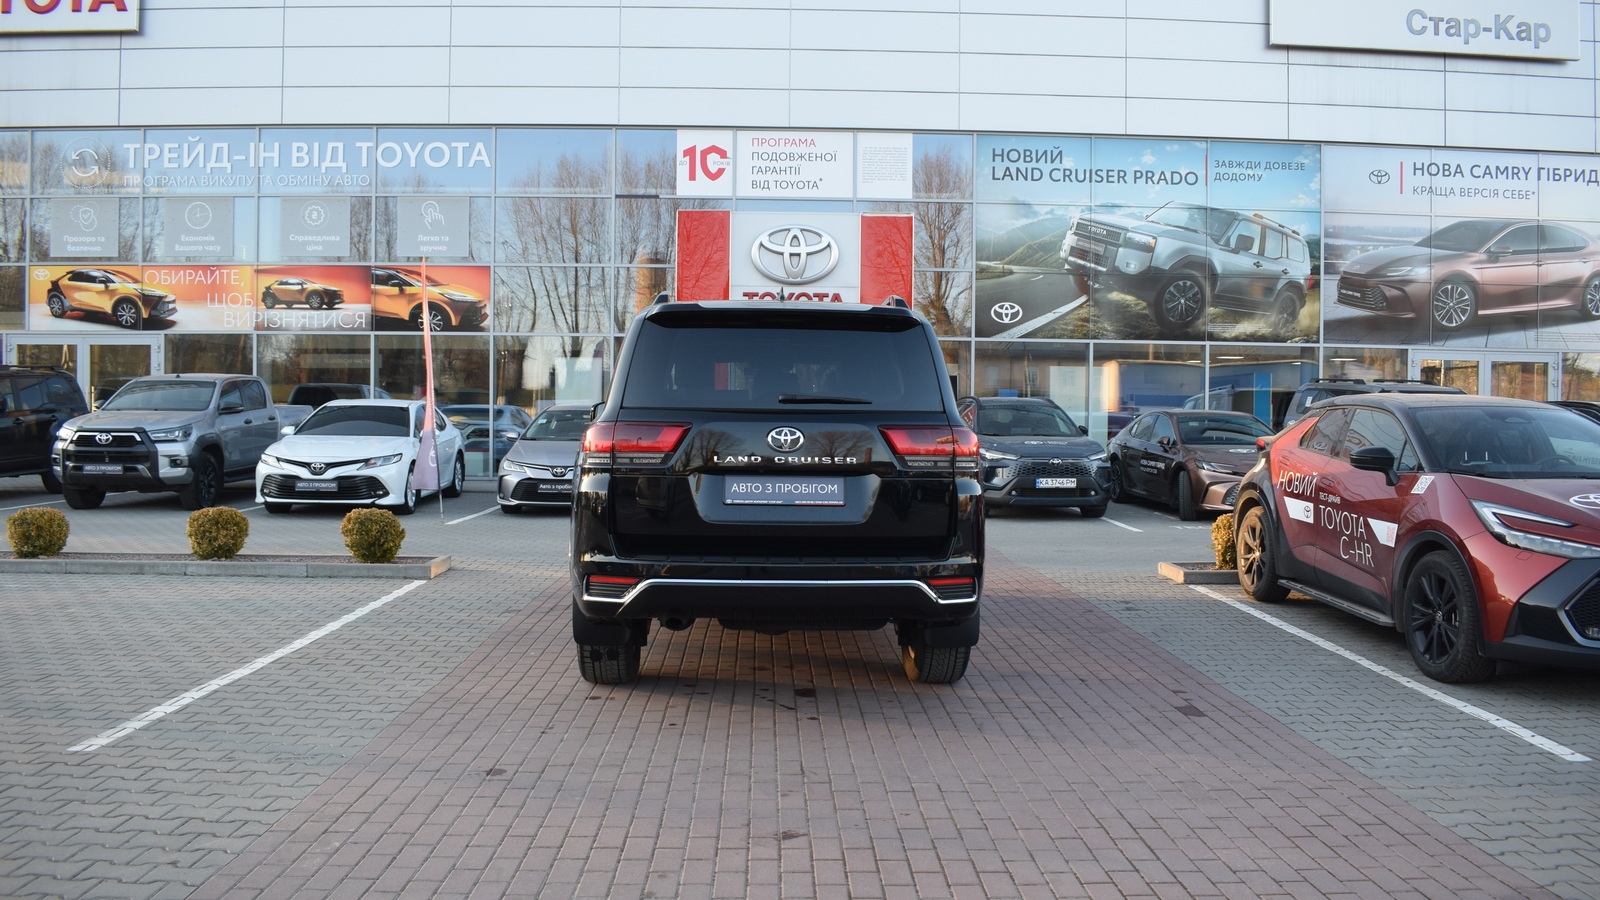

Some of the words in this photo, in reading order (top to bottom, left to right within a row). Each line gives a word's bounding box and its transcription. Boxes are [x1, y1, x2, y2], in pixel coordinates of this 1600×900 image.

[1406, 8, 1551, 49] Стар-Кар
[752, 138, 816, 148] ПРОГРАМА
[123, 136, 281, 174] ТРЕЙД-ІН
[291, 142, 347, 174] ВІД
[355, 142, 492, 168] TOYOTA
[752, 150, 838, 162] ПОДОВЖЕНОЇ
[992, 146, 1063, 164] НОВИЙ
[752, 164, 802, 176] ГАРАНТІЇ
[1214, 160, 1261, 170] ЗАВЖДИ
[1264, 160, 1306, 171] ДОВЕЗЕ
[124, 174, 198, 187] ПРОГРАМА
[202, 174, 256, 187] ВИКУПУ
[258, 174, 274, 186] ТА
[276, 174, 332, 186] ОБМІНУ
[334, 174, 370, 186] АВТО
[992, 166, 1044, 182] LAND
[1048, 168, 1128, 184] CRUISER
[1134, 170, 1198, 186] PRADO
[1214, 172, 1262, 182] ДОДОМУ
[1412, 162, 1464, 178] НОВА
[1470, 164, 1532, 181] CAMRY
[1538, 166, 1600, 186] ГІБРИД
[752, 180, 770, 191] ВІД
[1412, 186, 1456, 198] КРАЩА
[1460, 188, 1499, 198] ВЕРСІЯ
[64, 235, 92, 243] Прозоро
[289, 234, 340, 242] Справедлива
[144, 267, 244, 286] ОБИРАЙТЕ,
[207, 292, 254, 309] ЩОБ
[224, 311, 366, 328] ВИРІЗНЯТИСЯ
[774, 456, 857, 464] CRUISER
[731, 483, 762, 493] АВТО
[765, 484, 773, 493] З
[776, 484, 838, 494] ПРОБІГОМ
[1276, 470, 1318, 497] НОВИЙ
[1319, 505, 1366, 540] TOYOTA
[1340, 536, 1374, 568] C-HR
